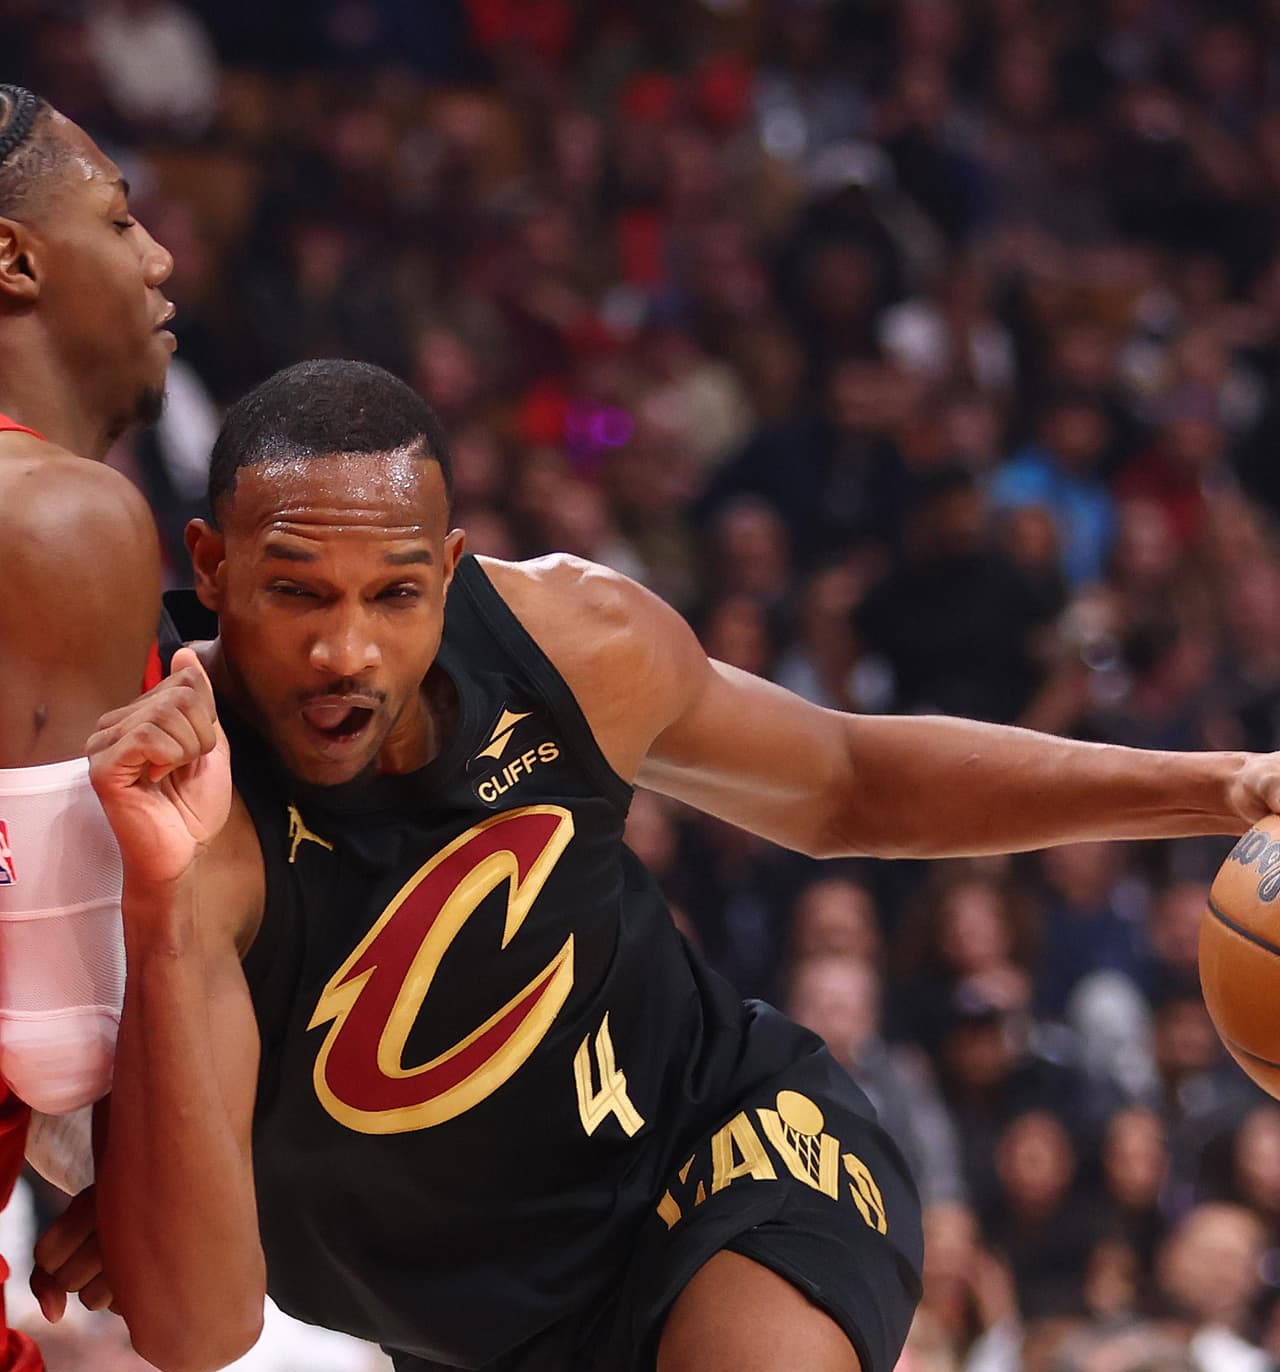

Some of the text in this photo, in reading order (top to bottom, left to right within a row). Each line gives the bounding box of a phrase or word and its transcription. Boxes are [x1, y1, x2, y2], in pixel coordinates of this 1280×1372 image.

[478, 741, 560, 803] CLIFFS
[306, 803, 575, 1135] C
[573, 1010, 645, 1138] 4
